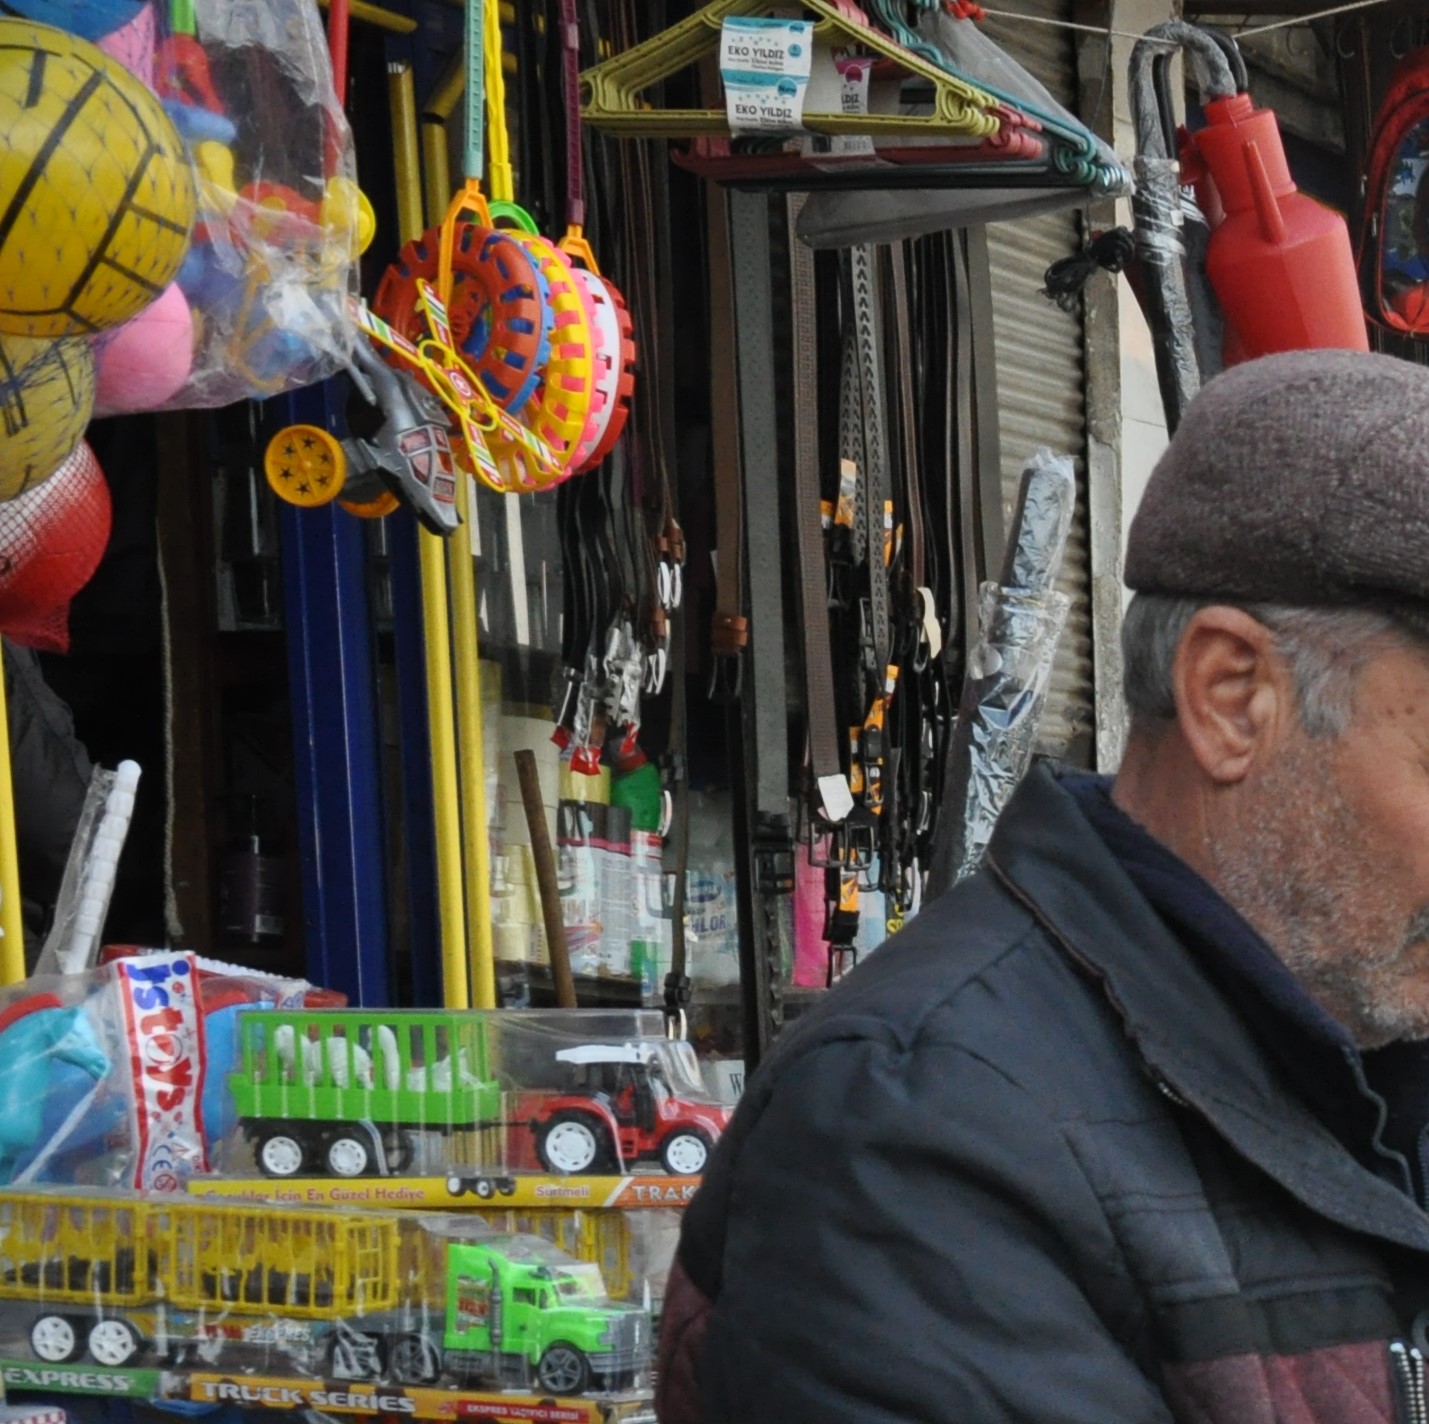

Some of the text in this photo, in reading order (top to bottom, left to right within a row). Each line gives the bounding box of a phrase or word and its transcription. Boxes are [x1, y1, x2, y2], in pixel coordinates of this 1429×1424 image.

[728, 45, 785, 60] EKO YILDIZ
[735, 104, 792, 119] EKO YILDIZ
[4, 1367, 131, 1392] EXPRESS
[202, 1381, 416, 1413] TRUCK SERIES
